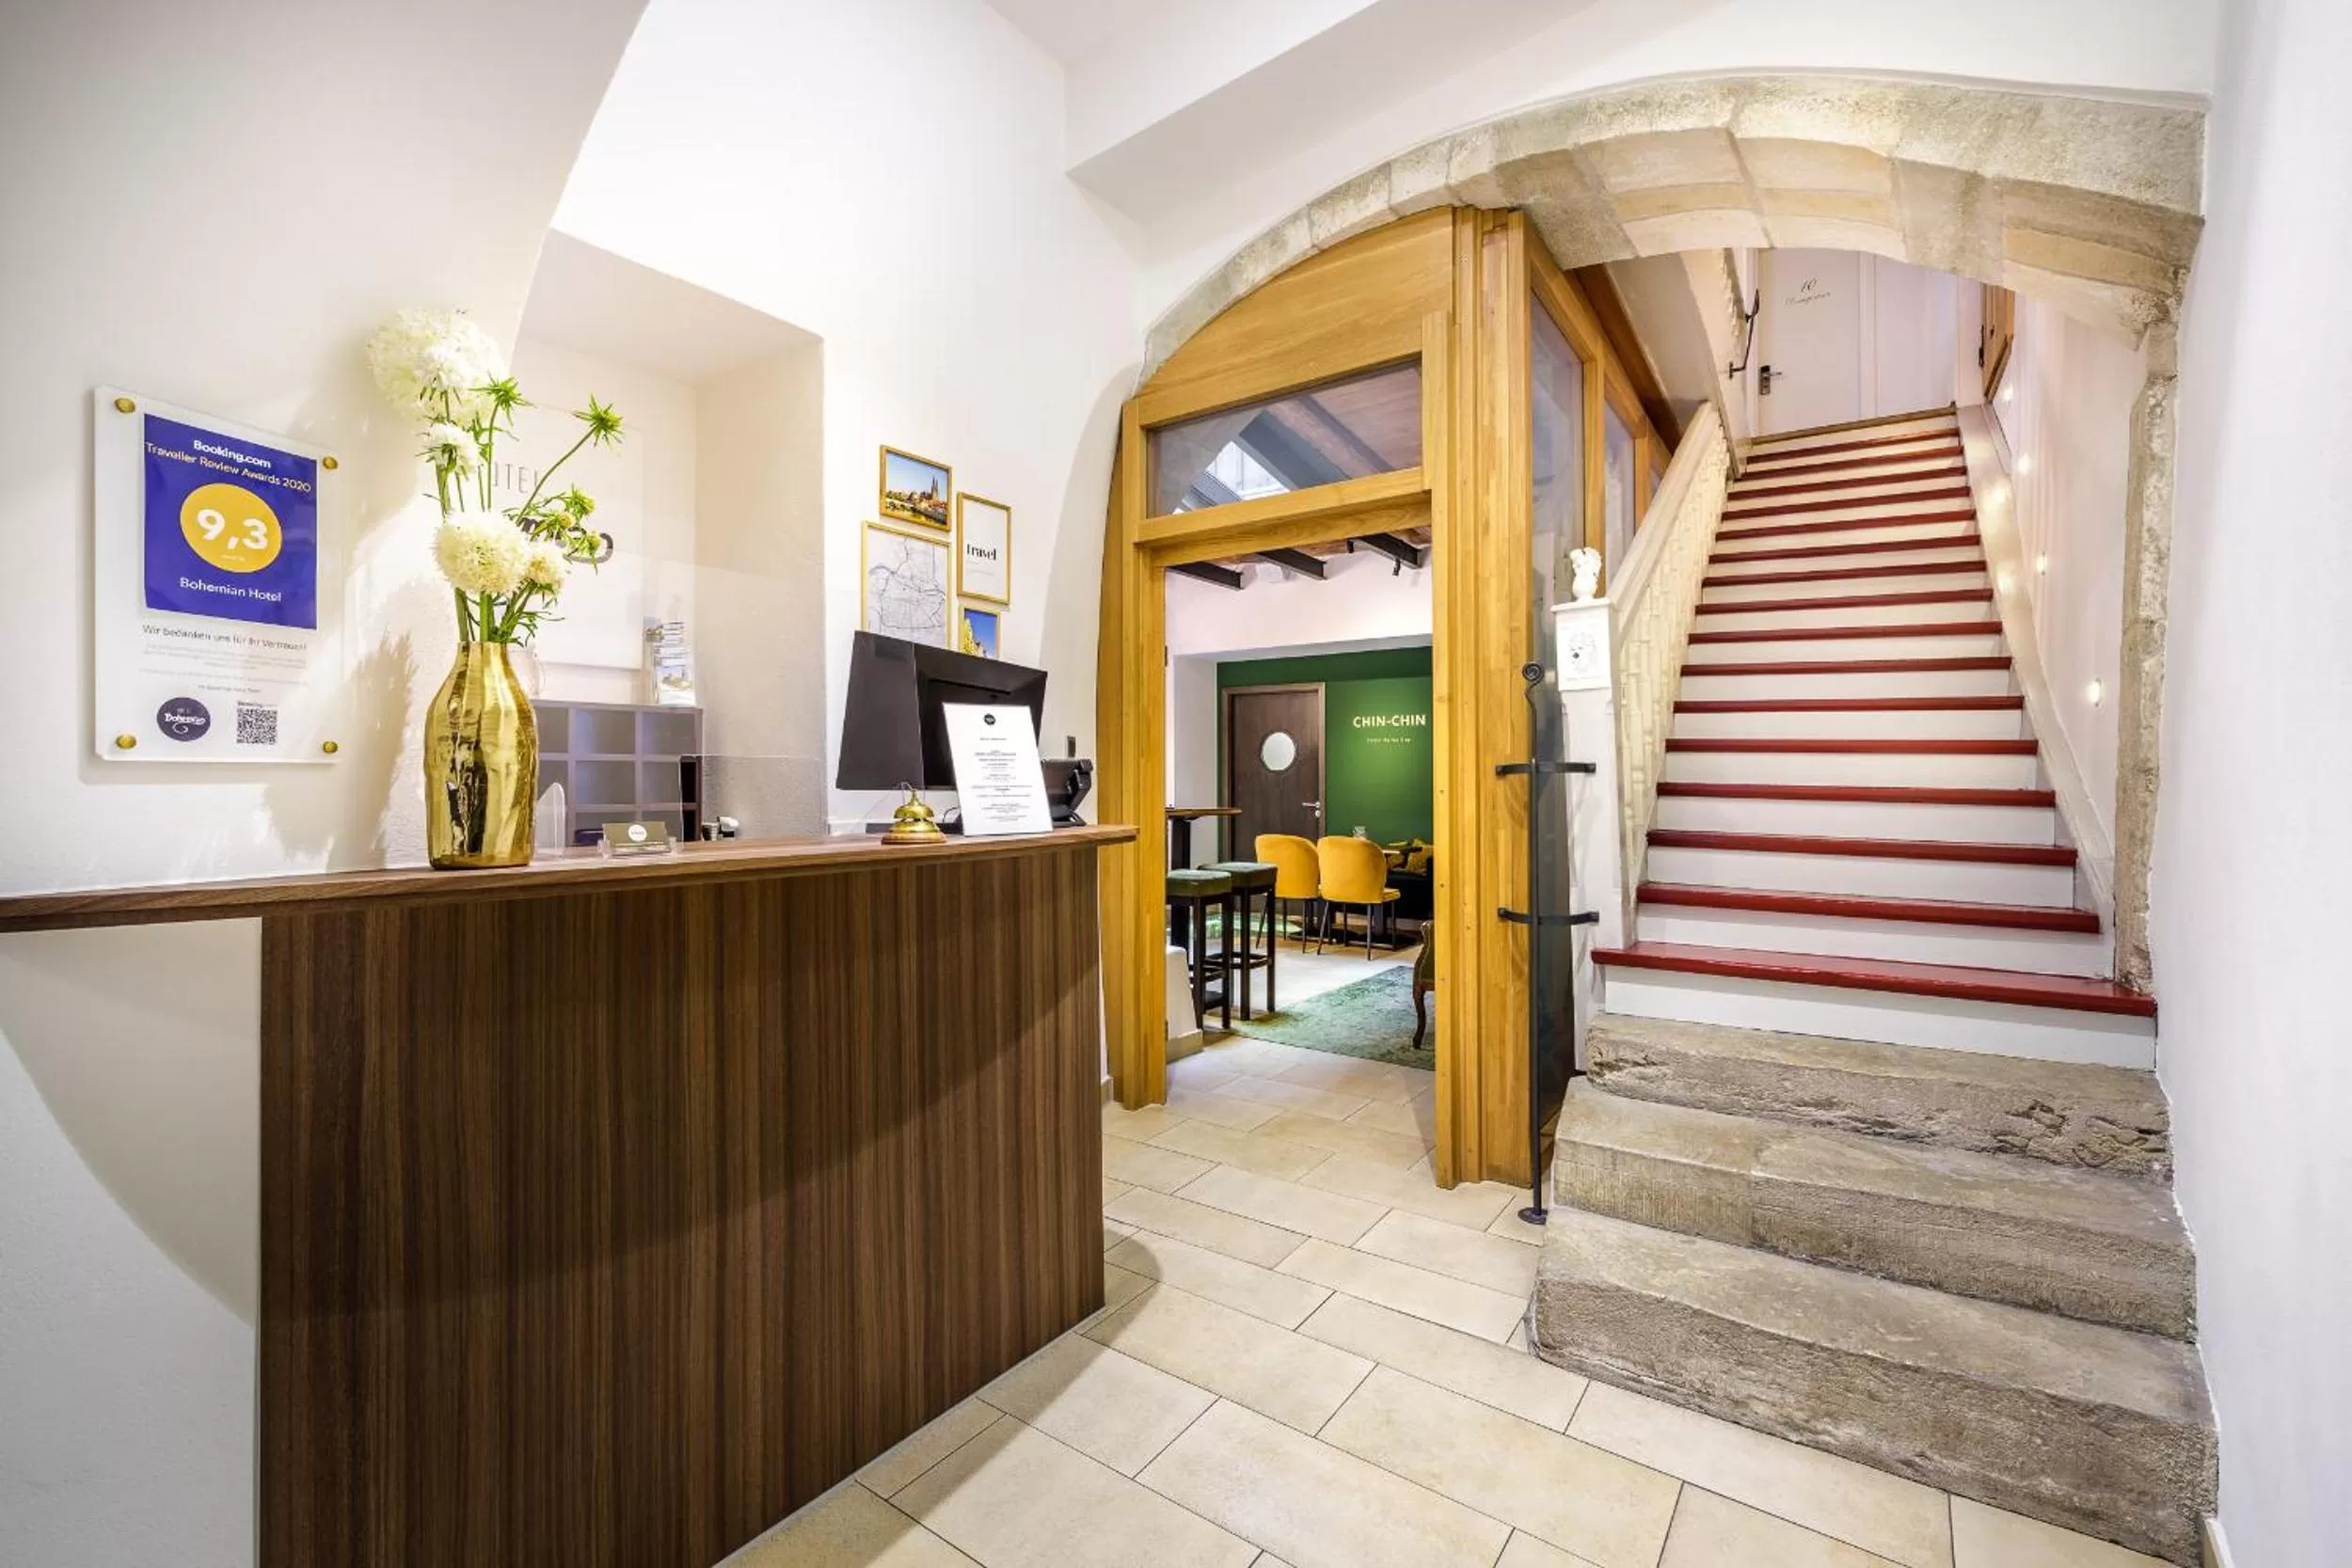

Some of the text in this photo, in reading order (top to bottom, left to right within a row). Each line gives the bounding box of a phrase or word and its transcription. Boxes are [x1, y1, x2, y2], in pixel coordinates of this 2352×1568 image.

[146, 441, 311, 494] Traveller Review Awards 2020
[193, 439, 272, 469] Booking.com
[197, 508, 268, 550] 9,3
[179, 577, 282, 603] Bohemian Hotel
[142, 625, 160, 636] Wir
[1353, 715, 1426, 728] CHIN-CHIN
